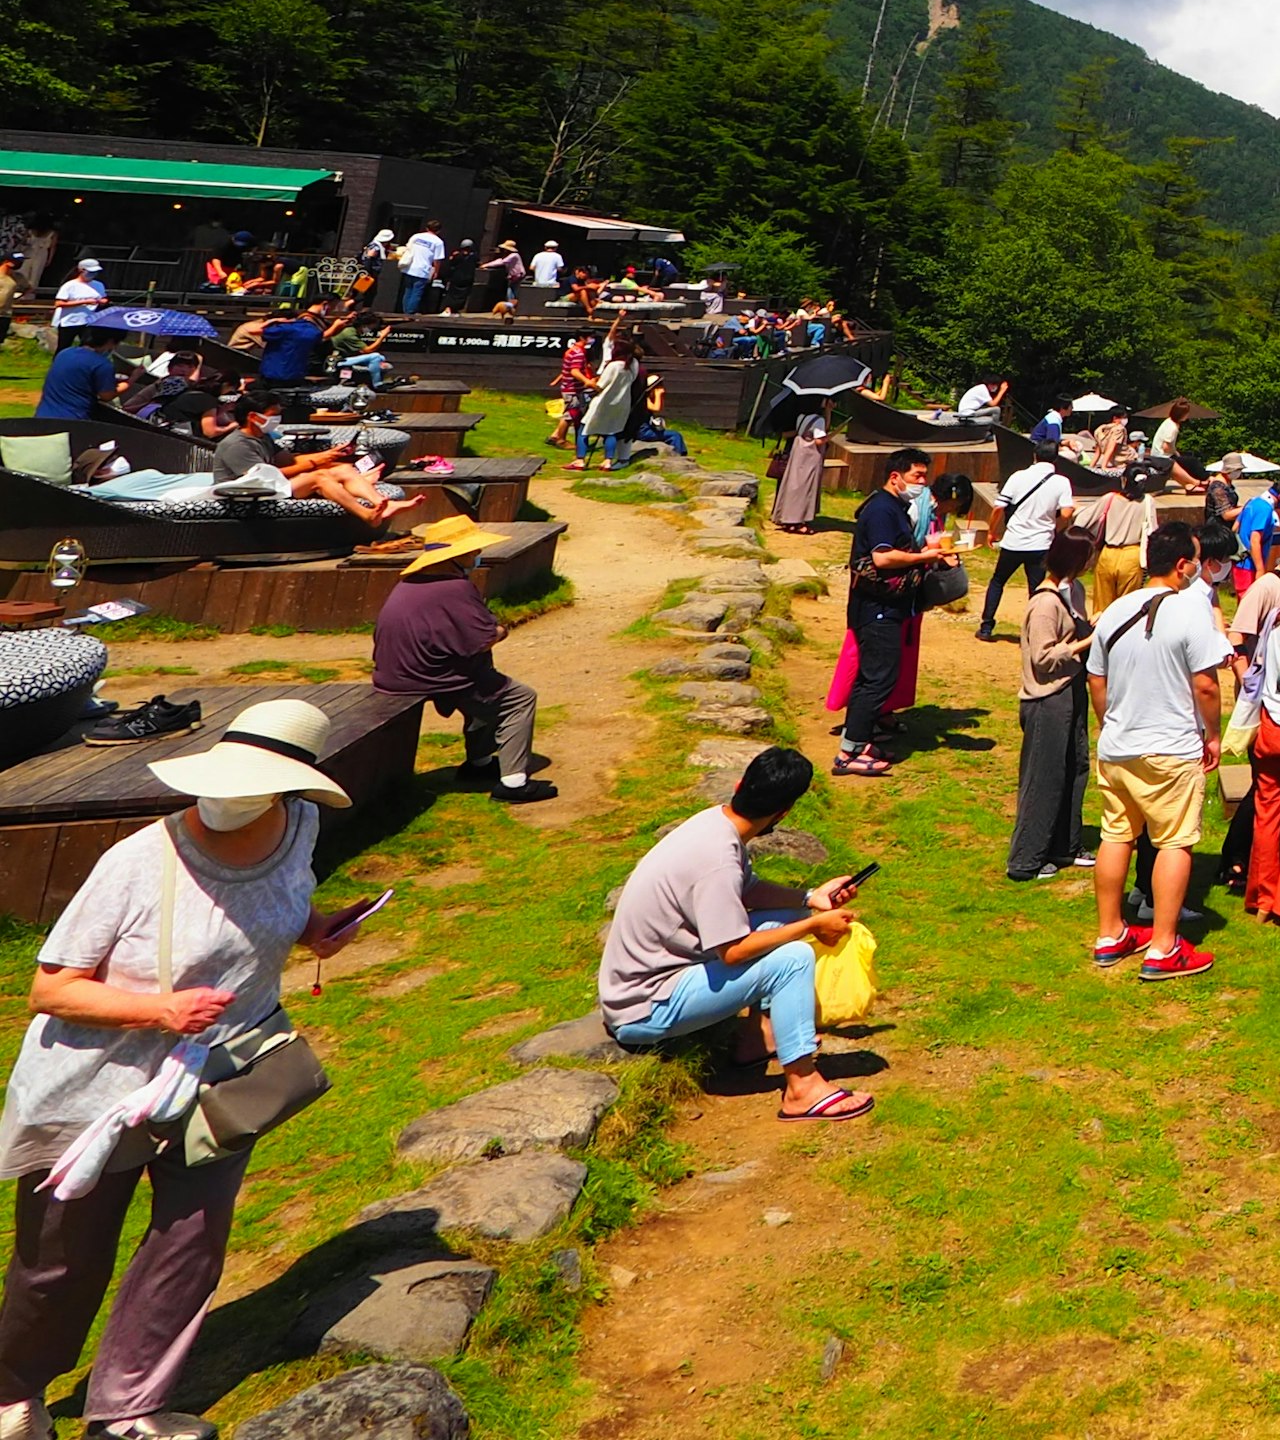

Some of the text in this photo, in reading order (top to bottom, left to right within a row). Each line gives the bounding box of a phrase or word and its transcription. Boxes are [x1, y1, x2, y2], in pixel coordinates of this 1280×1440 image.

[459, 337, 490, 346] 1,900m
[492, 334, 562, 348] 清里テラス
